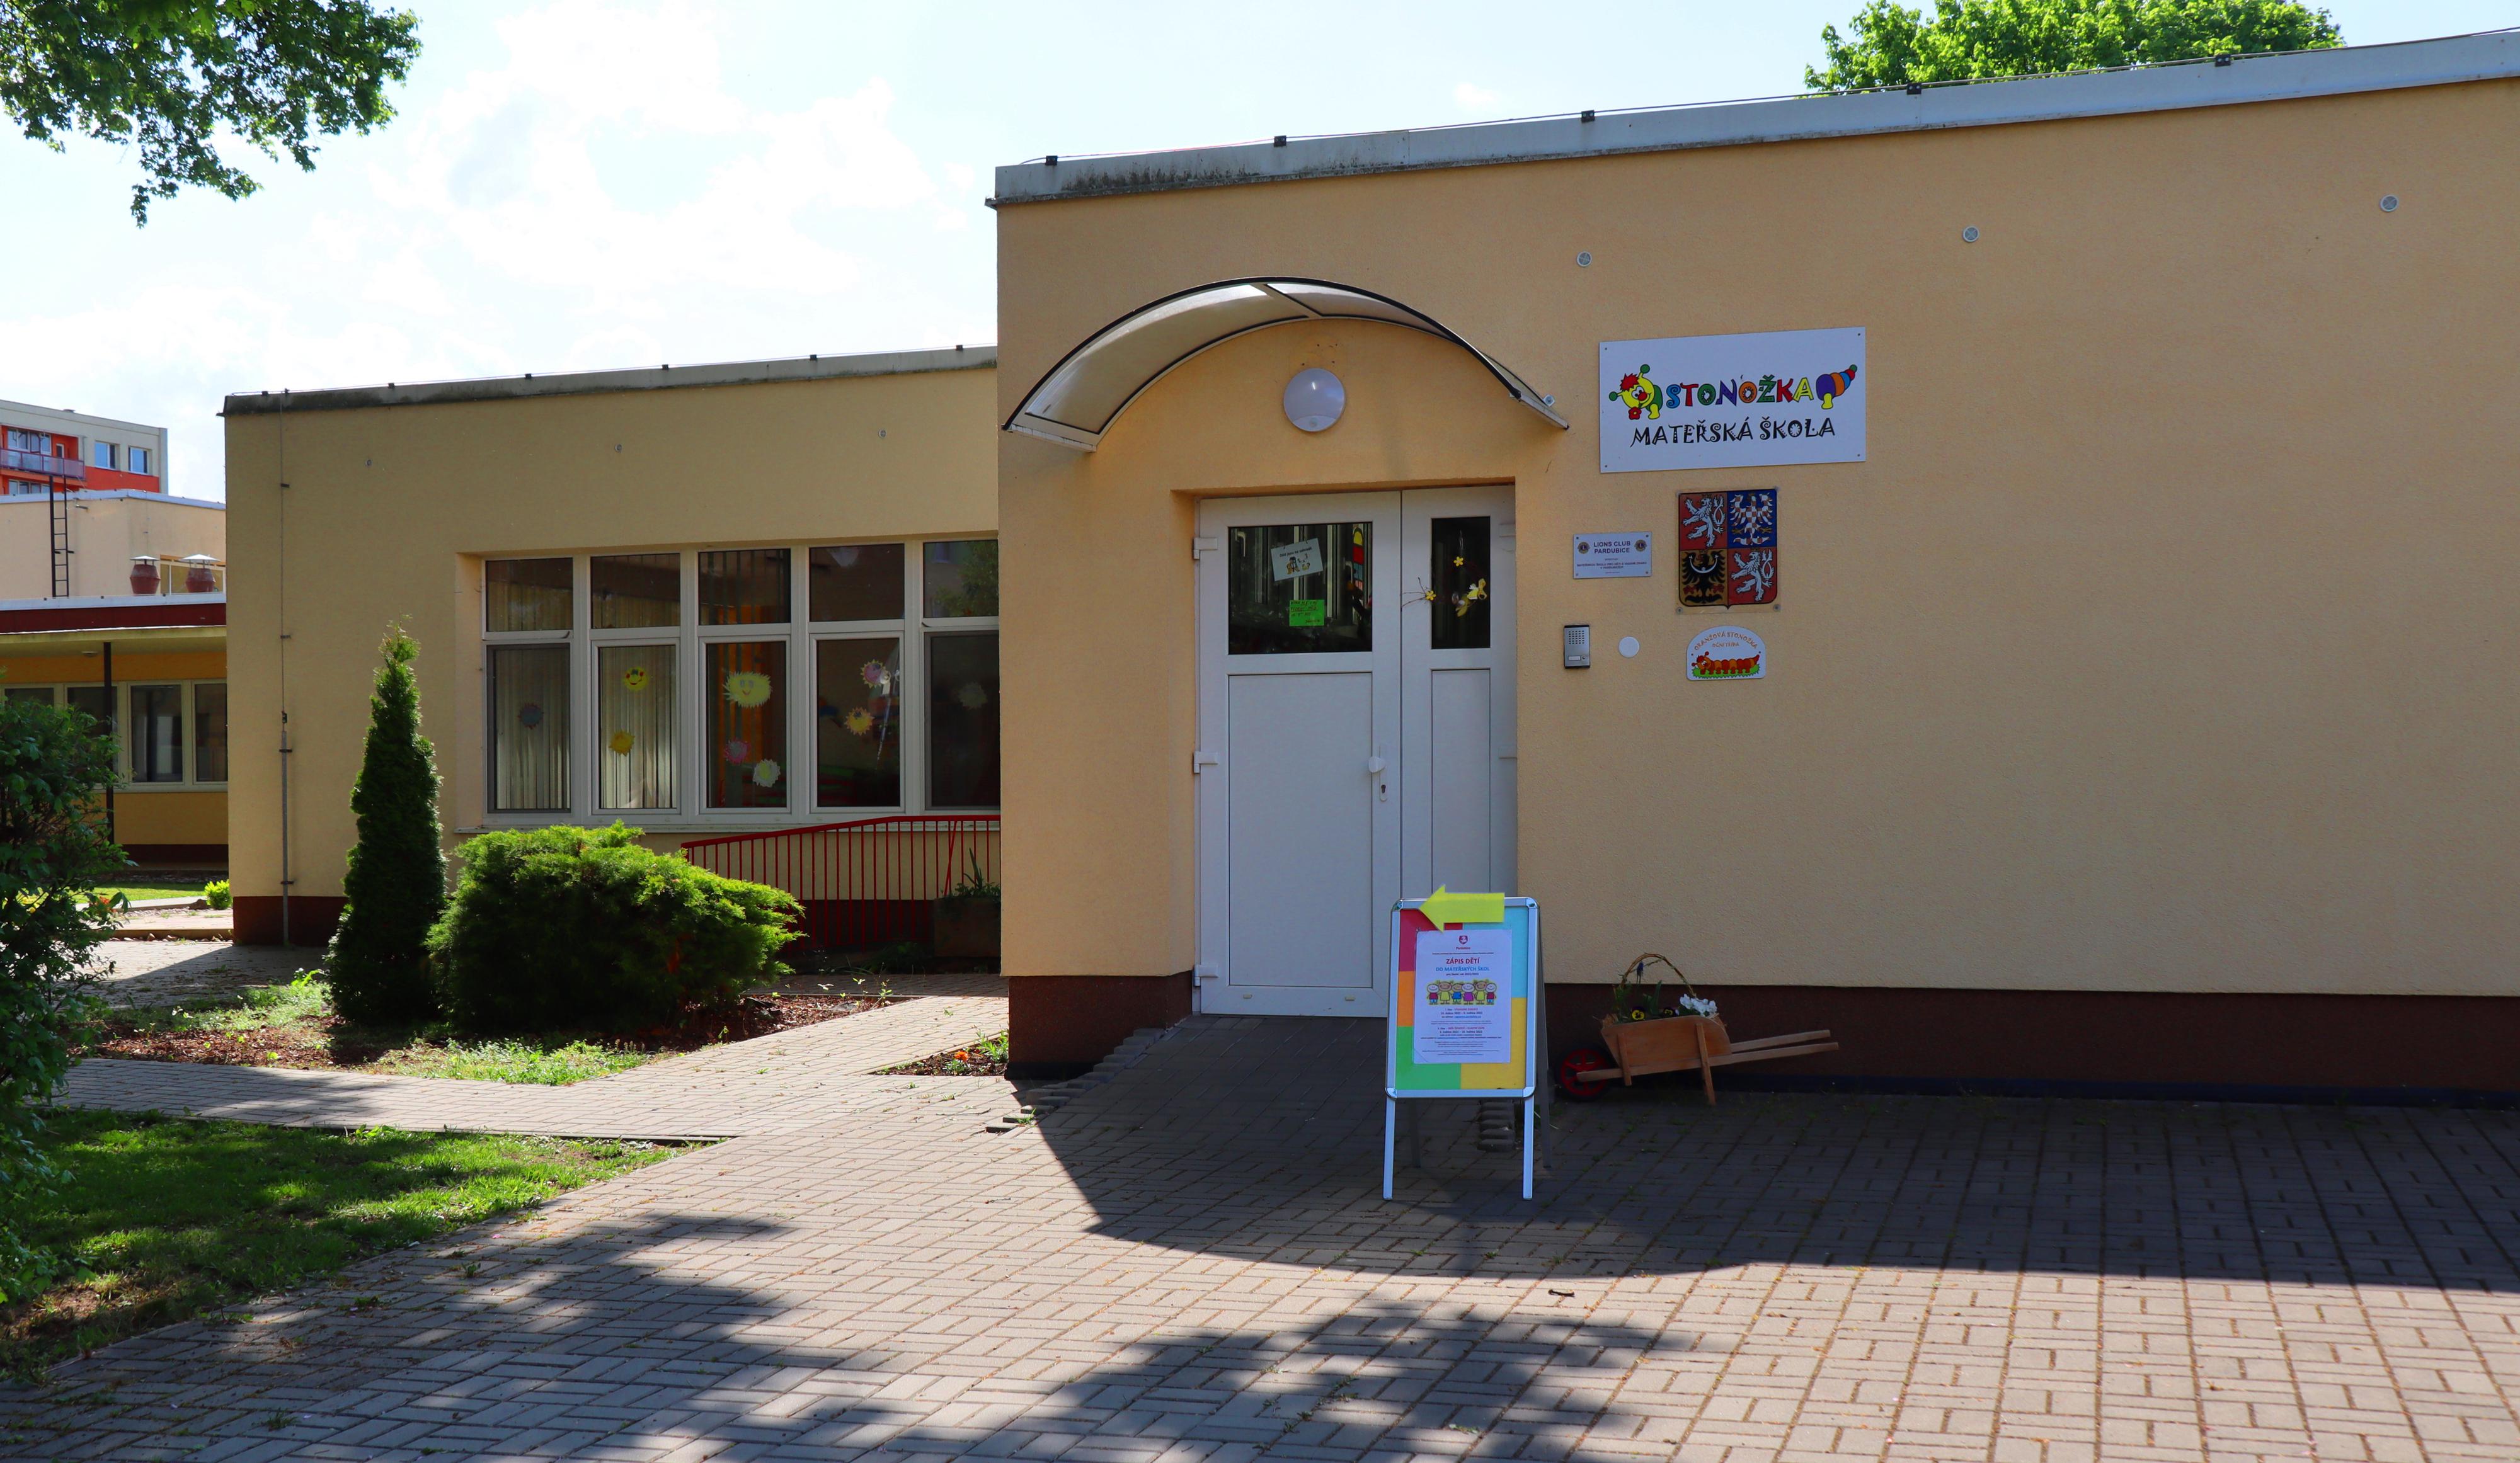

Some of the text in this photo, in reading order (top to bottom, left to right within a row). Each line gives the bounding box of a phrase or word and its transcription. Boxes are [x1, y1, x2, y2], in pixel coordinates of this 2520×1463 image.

[1666, 374, 1814, 409] STONOŽKA
[1630, 416, 1835, 448] MATEŘSKÁ ŠKOLA
[1446, 957, 1464, 965] ZÁPIS
